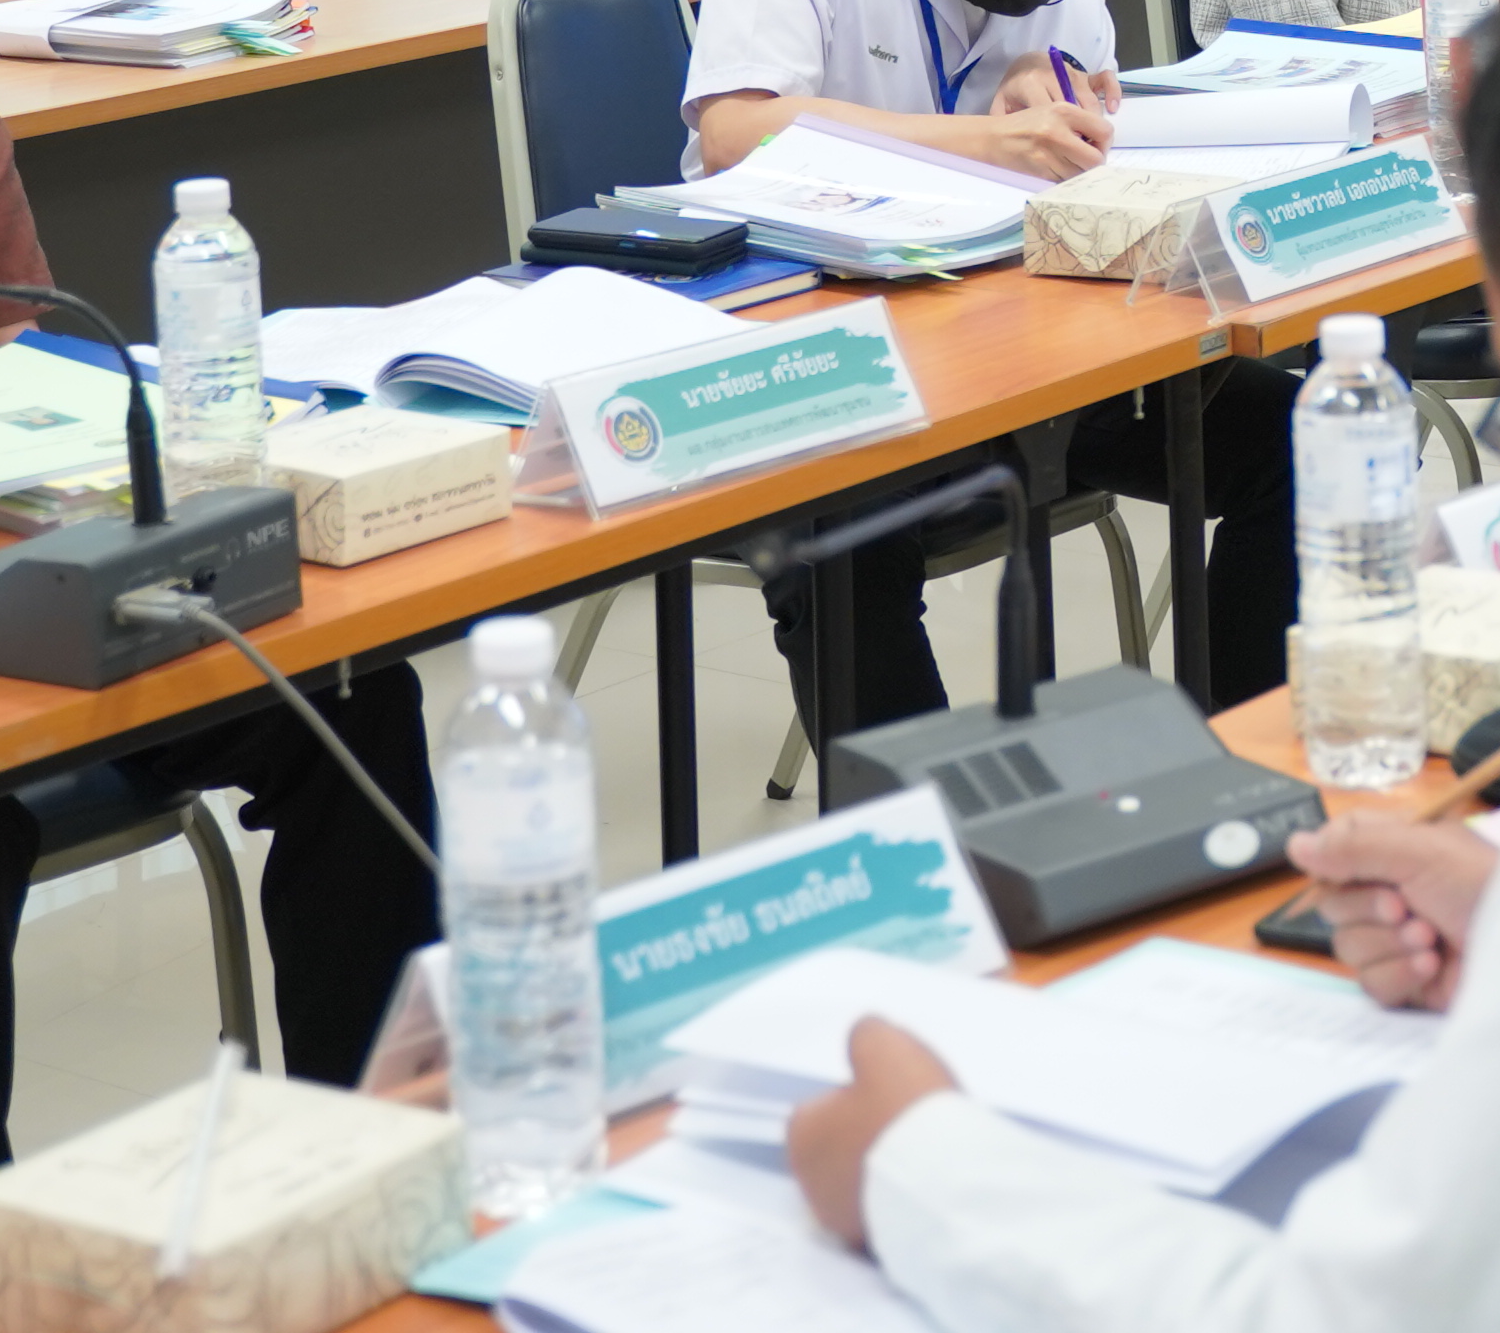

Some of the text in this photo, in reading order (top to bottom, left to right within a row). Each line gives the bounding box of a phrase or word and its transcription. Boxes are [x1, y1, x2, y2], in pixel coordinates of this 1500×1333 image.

[1267, 179, 1346, 225] นายชัชวาลย์
[681, 350, 839, 408] นายชัยยะ ศรีชัยยะ
[612, 902, 750, 982] นายธงชัย
